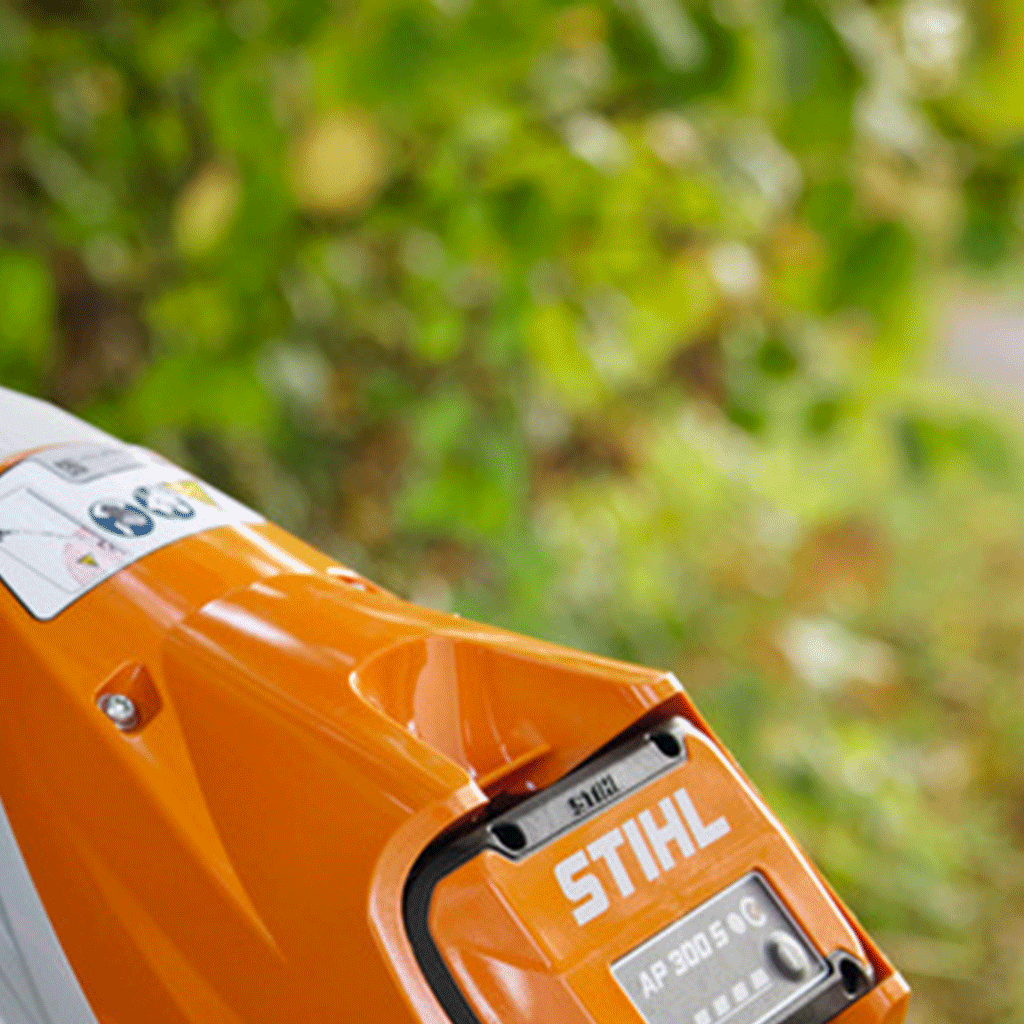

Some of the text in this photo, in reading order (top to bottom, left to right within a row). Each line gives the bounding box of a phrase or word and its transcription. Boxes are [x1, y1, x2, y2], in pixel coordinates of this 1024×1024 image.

[553, 788, 731, 926] STIHL
[639, 959, 669, 999] AP
[667, 932, 714, 977] 300
